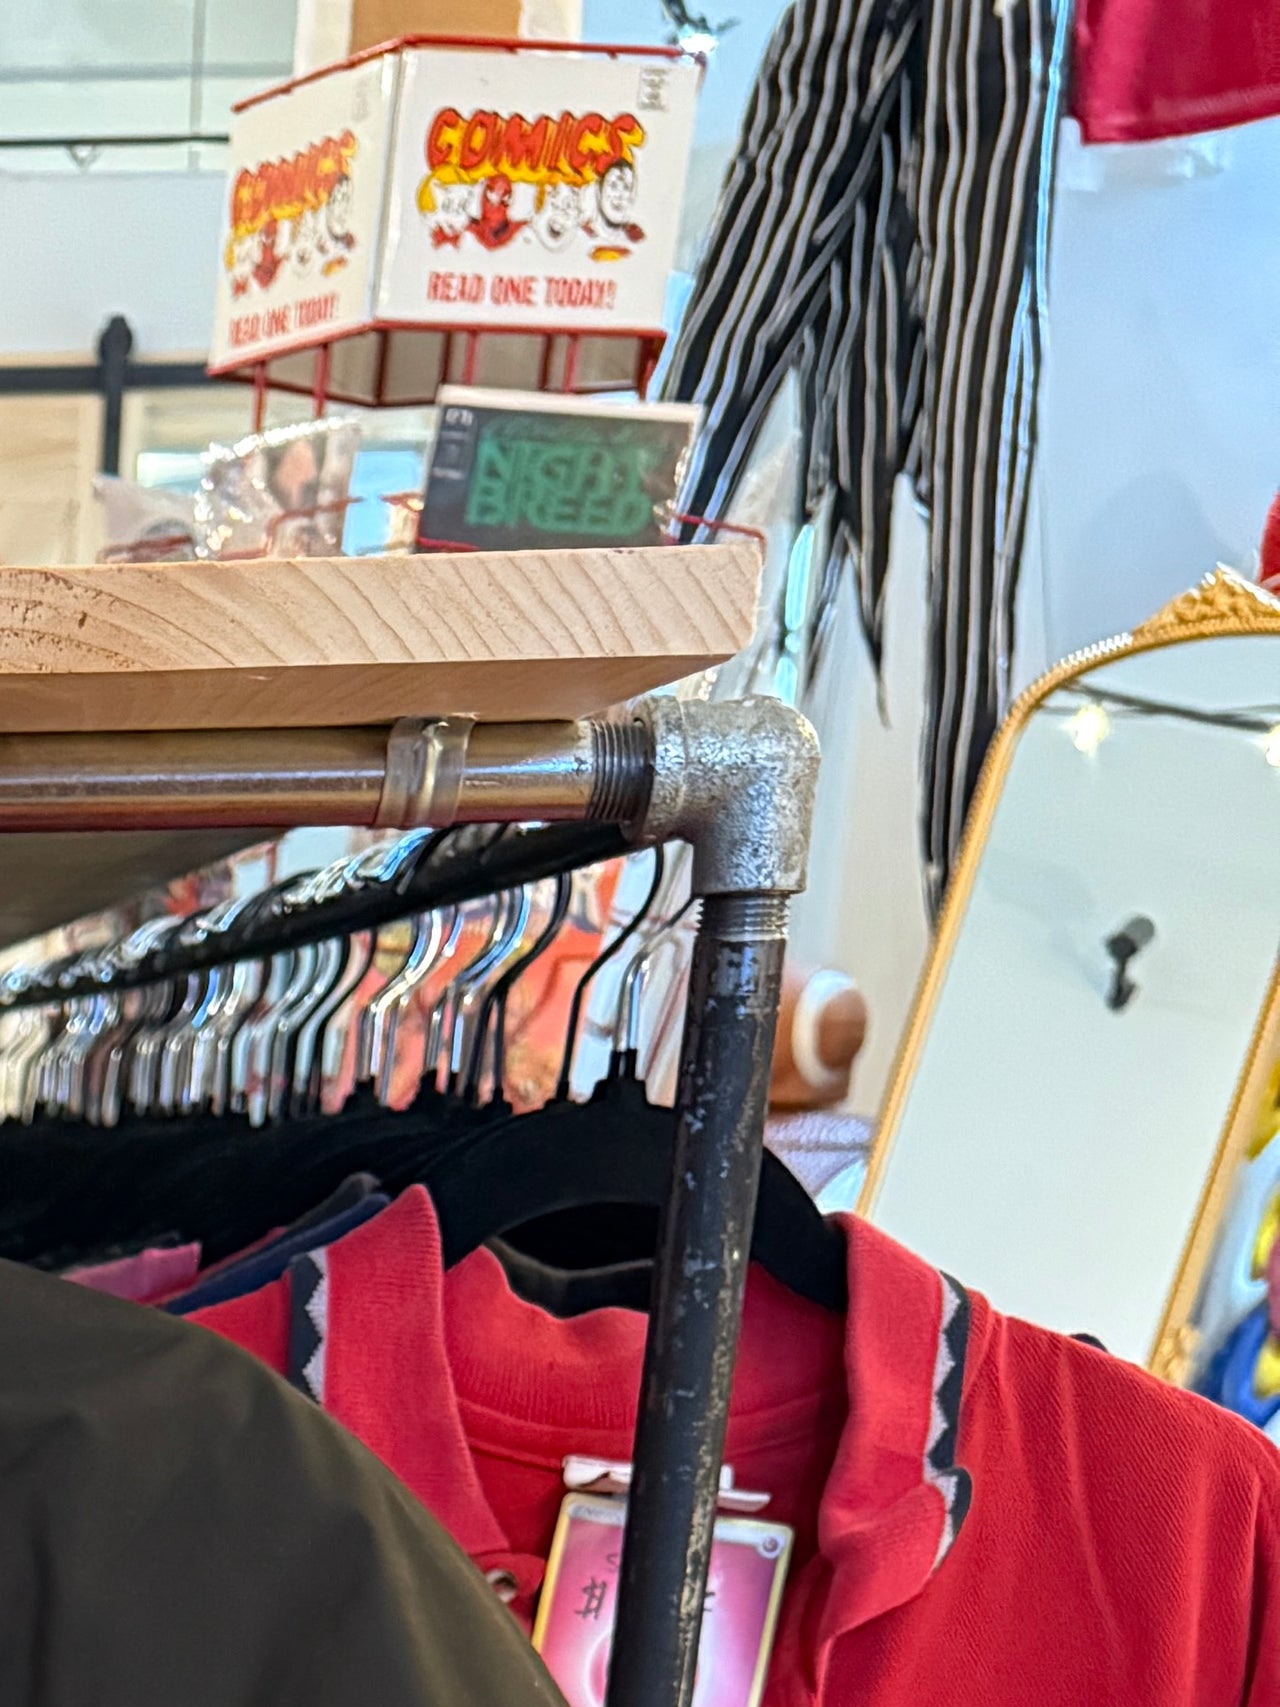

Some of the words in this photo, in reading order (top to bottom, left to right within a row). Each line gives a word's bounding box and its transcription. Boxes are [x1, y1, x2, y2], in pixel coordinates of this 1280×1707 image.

[426, 107, 644, 178] COMICS
[427, 272, 483, 302] READ
[490, 275, 538, 307] ONE
[545, 277, 617, 309] TODAY!
